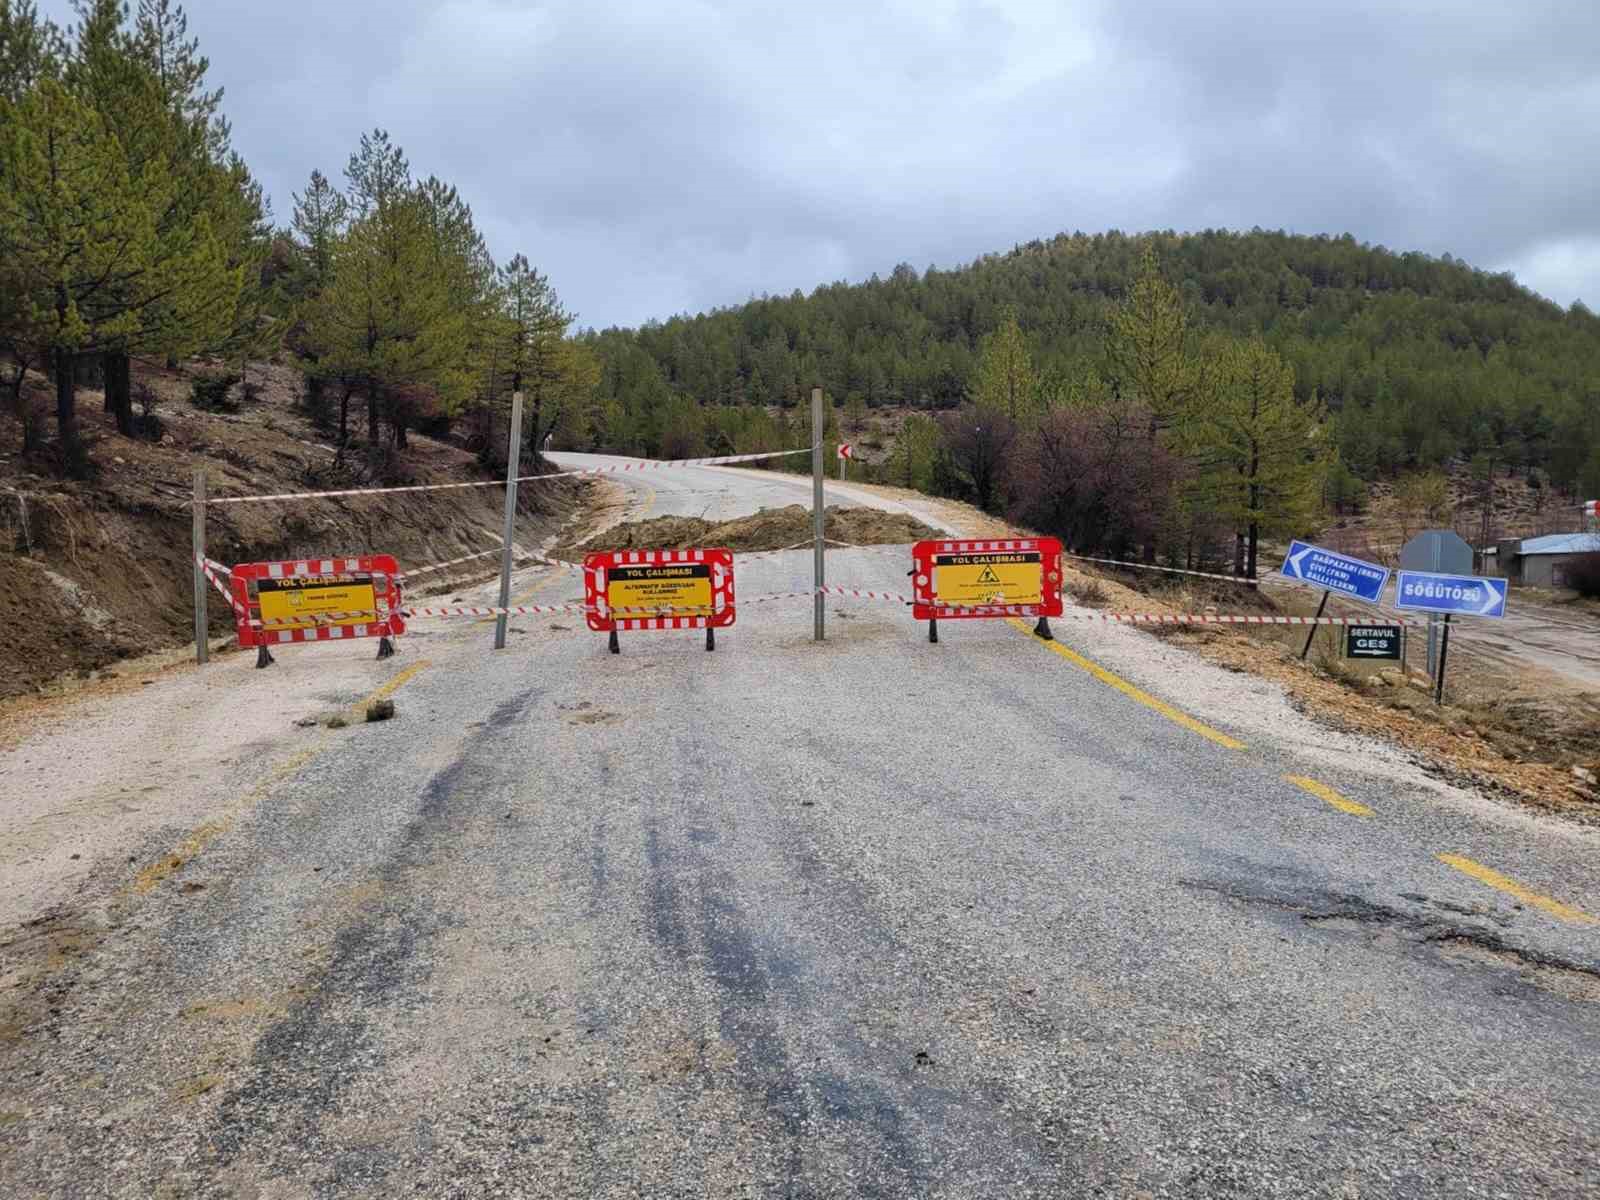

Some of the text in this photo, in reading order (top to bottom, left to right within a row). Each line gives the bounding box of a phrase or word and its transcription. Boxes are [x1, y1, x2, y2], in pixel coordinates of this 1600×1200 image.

[952, 557, 970, 565] YOL
[626, 567, 692, 578] YOL ÇALIŞMASI
[276, 578, 297, 588] YOL
[1404, 582, 1482, 602] SÖĞÜTÖZÜ
[1351, 627, 1395, 638] SERTAVUL
[1356, 639, 1388, 649] GES
